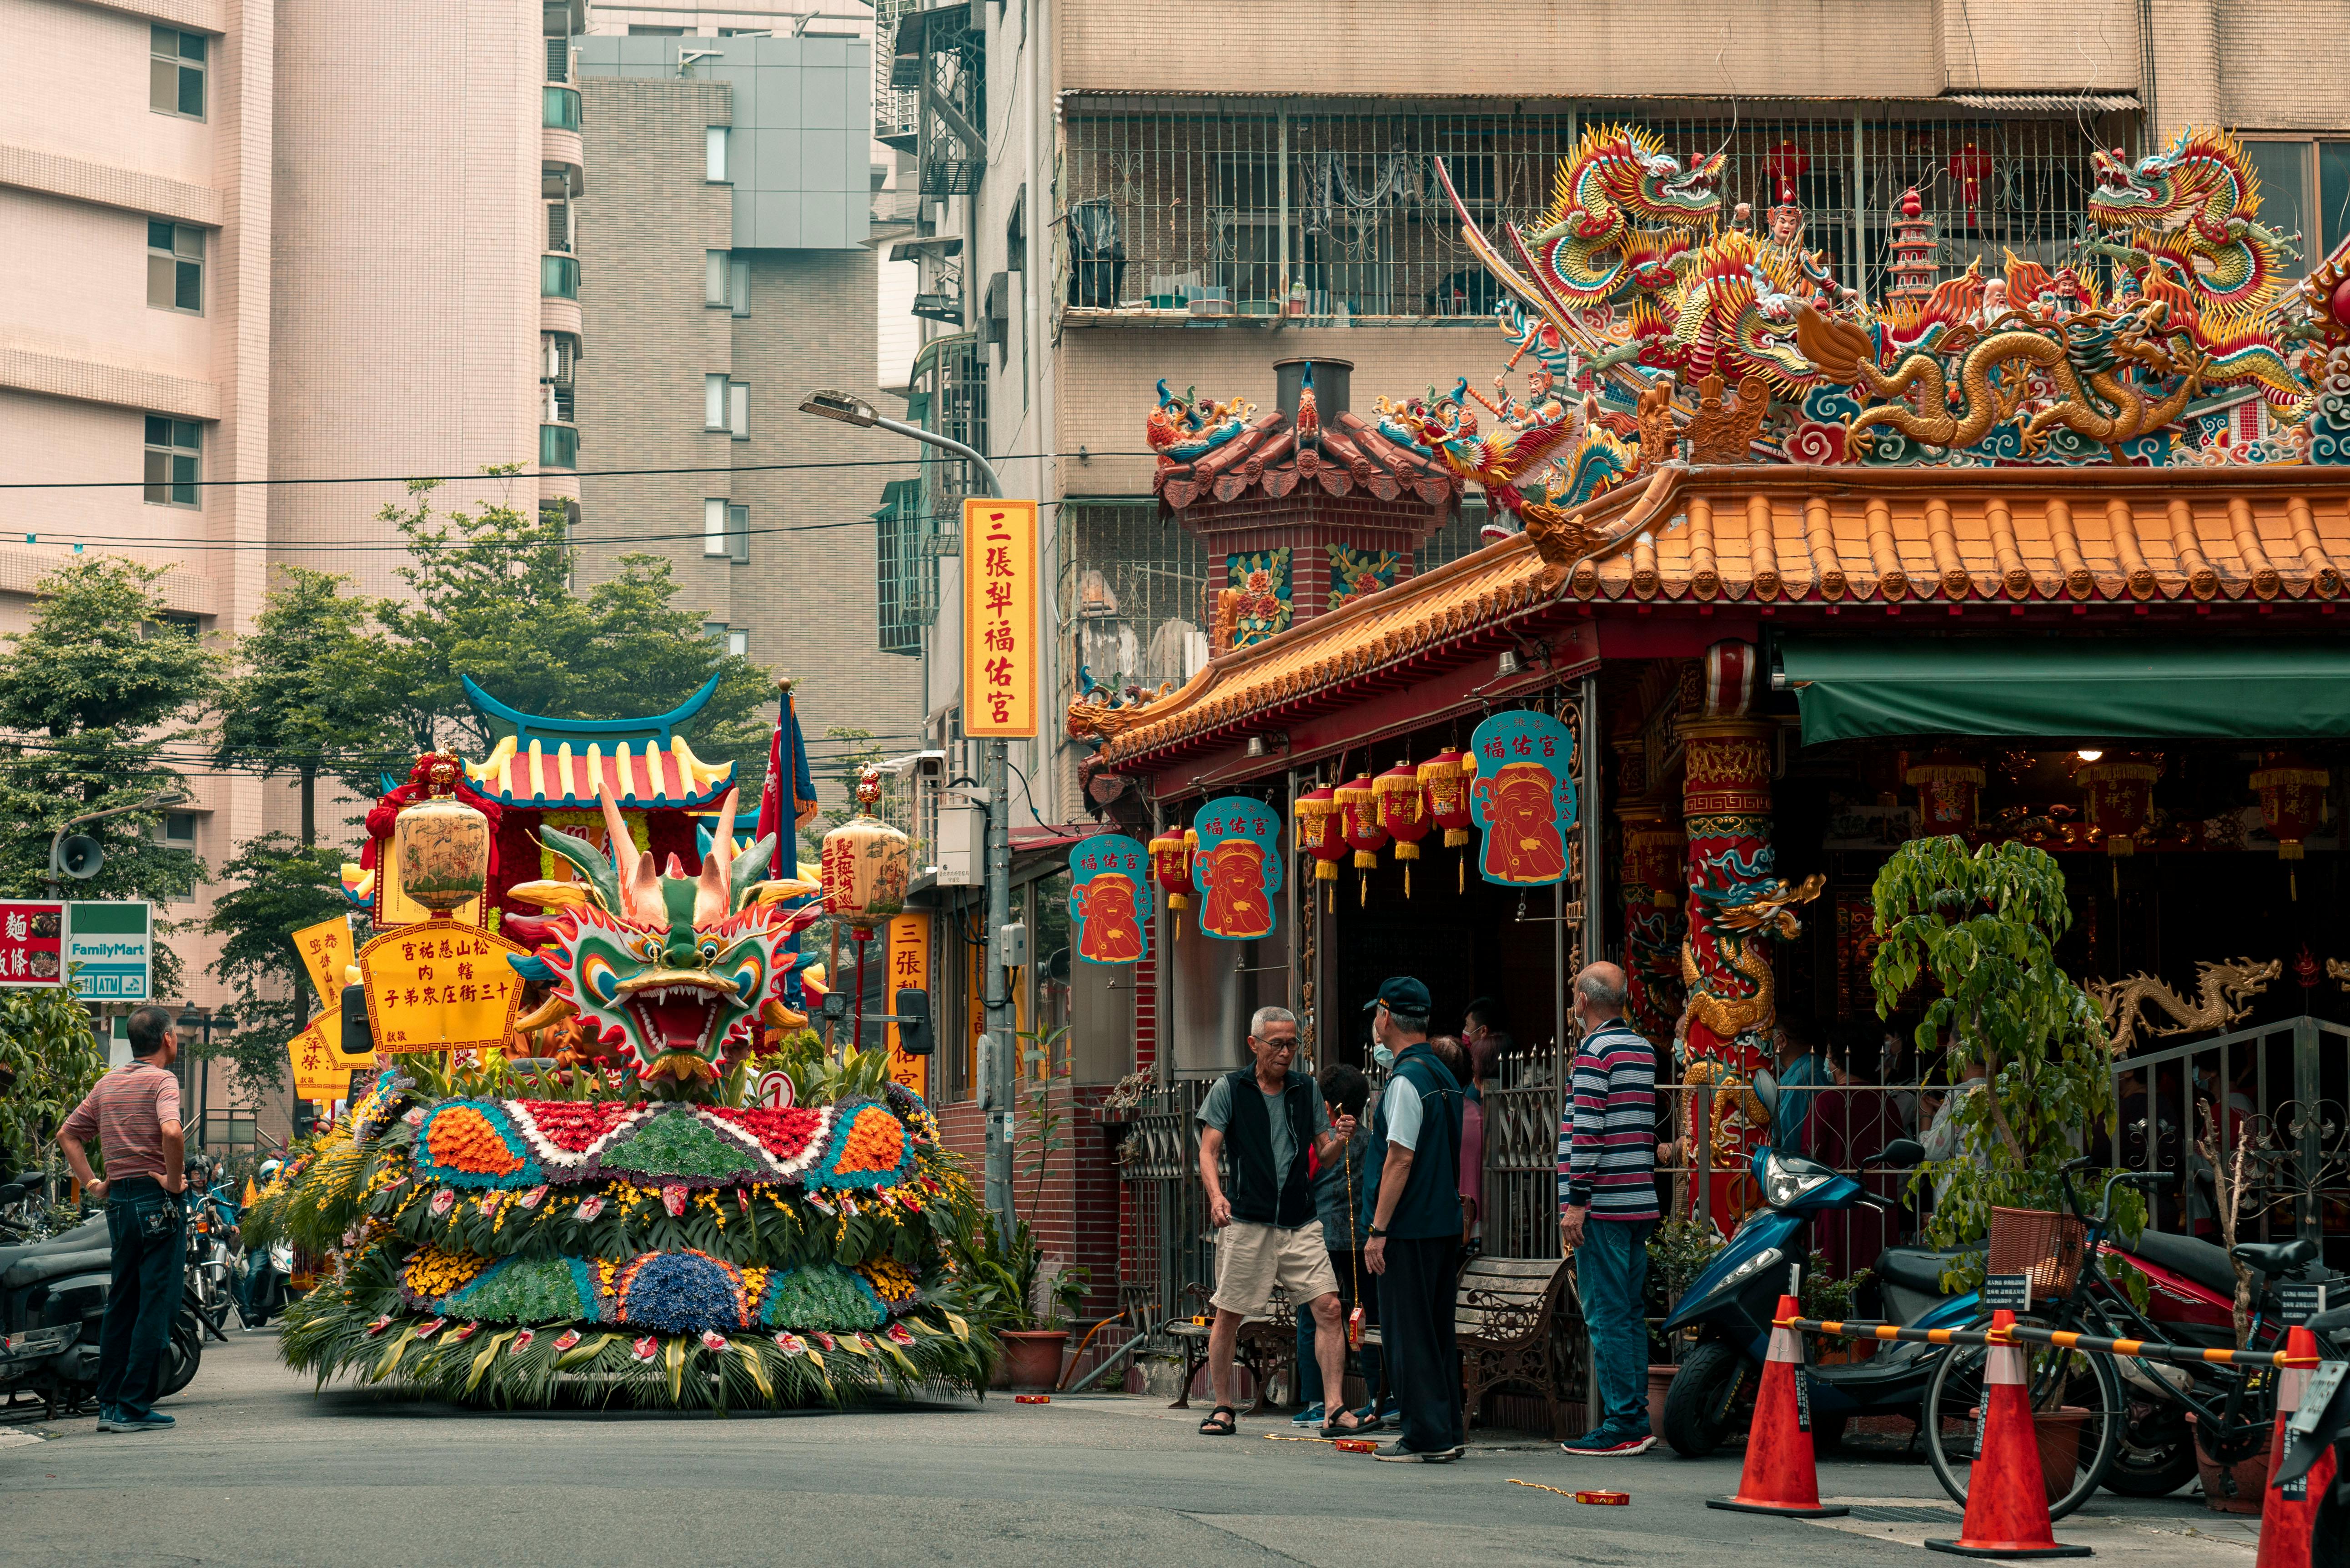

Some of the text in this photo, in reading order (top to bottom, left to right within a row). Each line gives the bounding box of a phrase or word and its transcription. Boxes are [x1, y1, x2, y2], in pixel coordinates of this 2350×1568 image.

[984, 513, 1015, 724] 三張犁福佑宮
[1496, 717, 1545, 732] 三張犁
[1483, 733, 1559, 759] 福佑宮
[1559, 778, 1572, 820] 土地公
[1204, 816, 1270, 836] 福佑宮
[1080, 852, 1140, 870] 福佑宮
[1267, 853, 1279, 887] 土地公
[1138, 885, 1149, 917] 土地公
[5, 911, 27, 941] 麵
[72, 943, 145, 958] FamilyMart
[402, 938, 490, 961] 松山慈祐宮
[100, 978, 117, 992] ATM
[893, 924, 922, 1089] 三張佑宮
